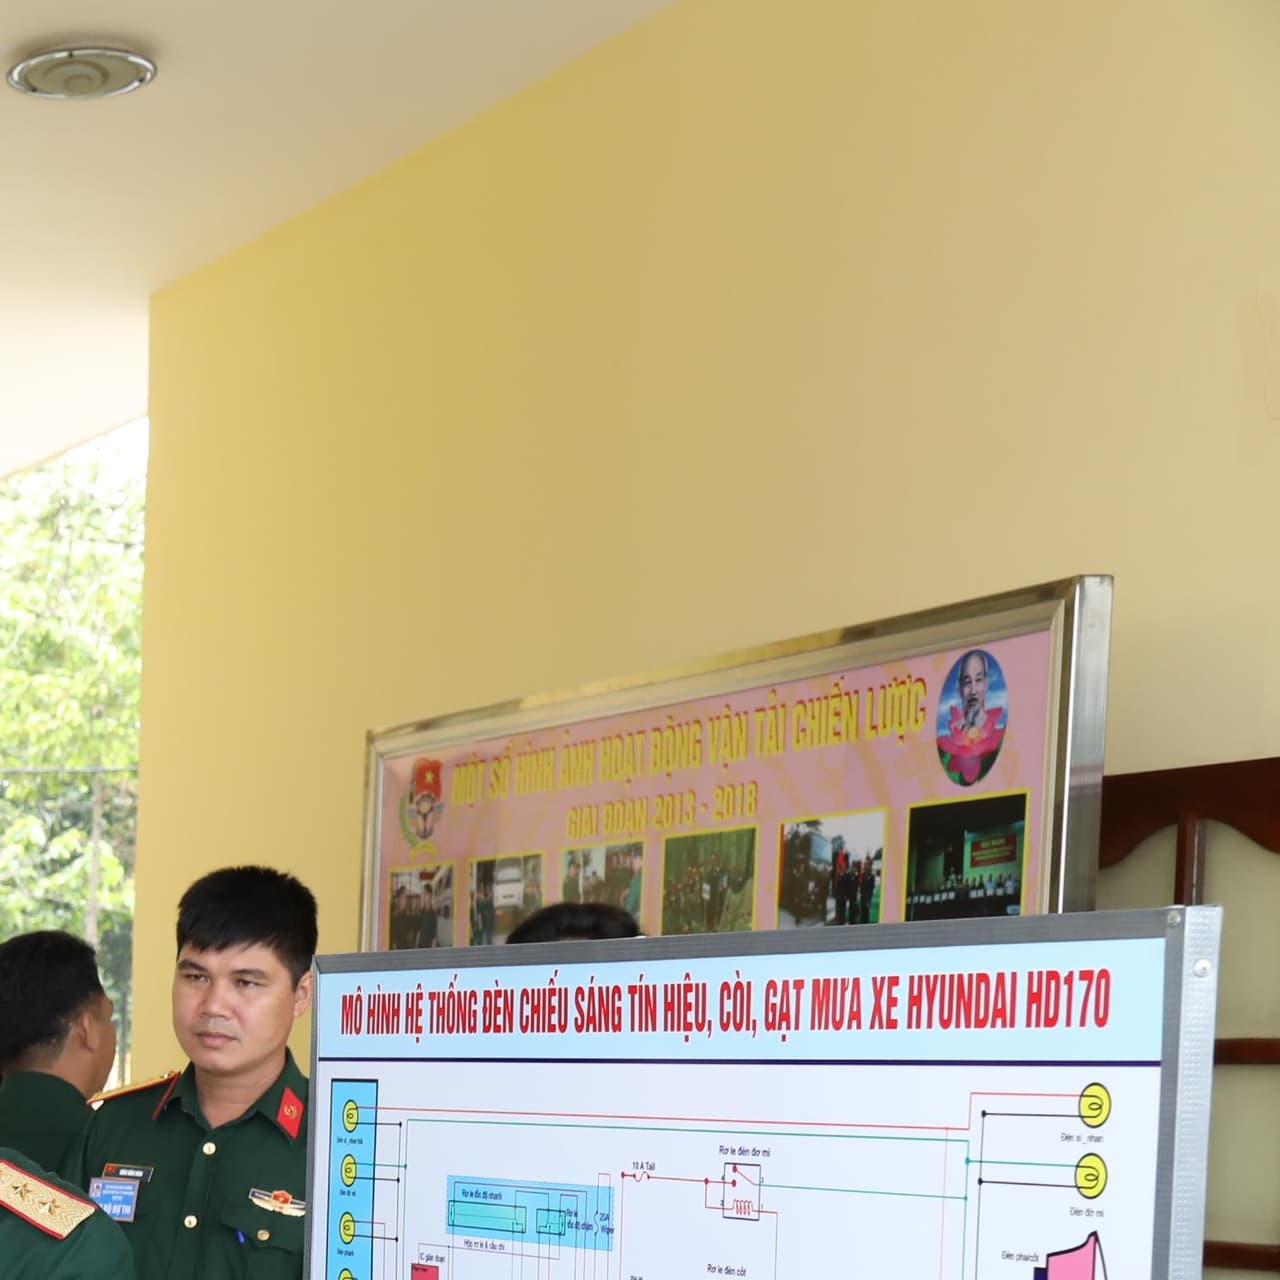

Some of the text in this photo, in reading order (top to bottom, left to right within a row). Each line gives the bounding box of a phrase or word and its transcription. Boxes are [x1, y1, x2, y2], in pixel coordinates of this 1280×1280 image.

[600, 730, 646, 788] HOẠT
[649, 714, 702, 783] ĐỘNG
[708, 704, 748, 774] VẬN
[754, 689, 787, 757] TẢI
[792, 676, 860, 752] CHIẾN
[864, 674, 927, 746] LƯỢC
[653, 789, 696, 829] 2013
[712, 780, 758, 821] 2018
[340, 968, 1112, 1044] MÔ HÌNH HỆ THỐNG ĐÈN CHIẾU SÁNG TÍN HIỆU, CÒI, GẠT MƯA XE HYUNDAI HD170
